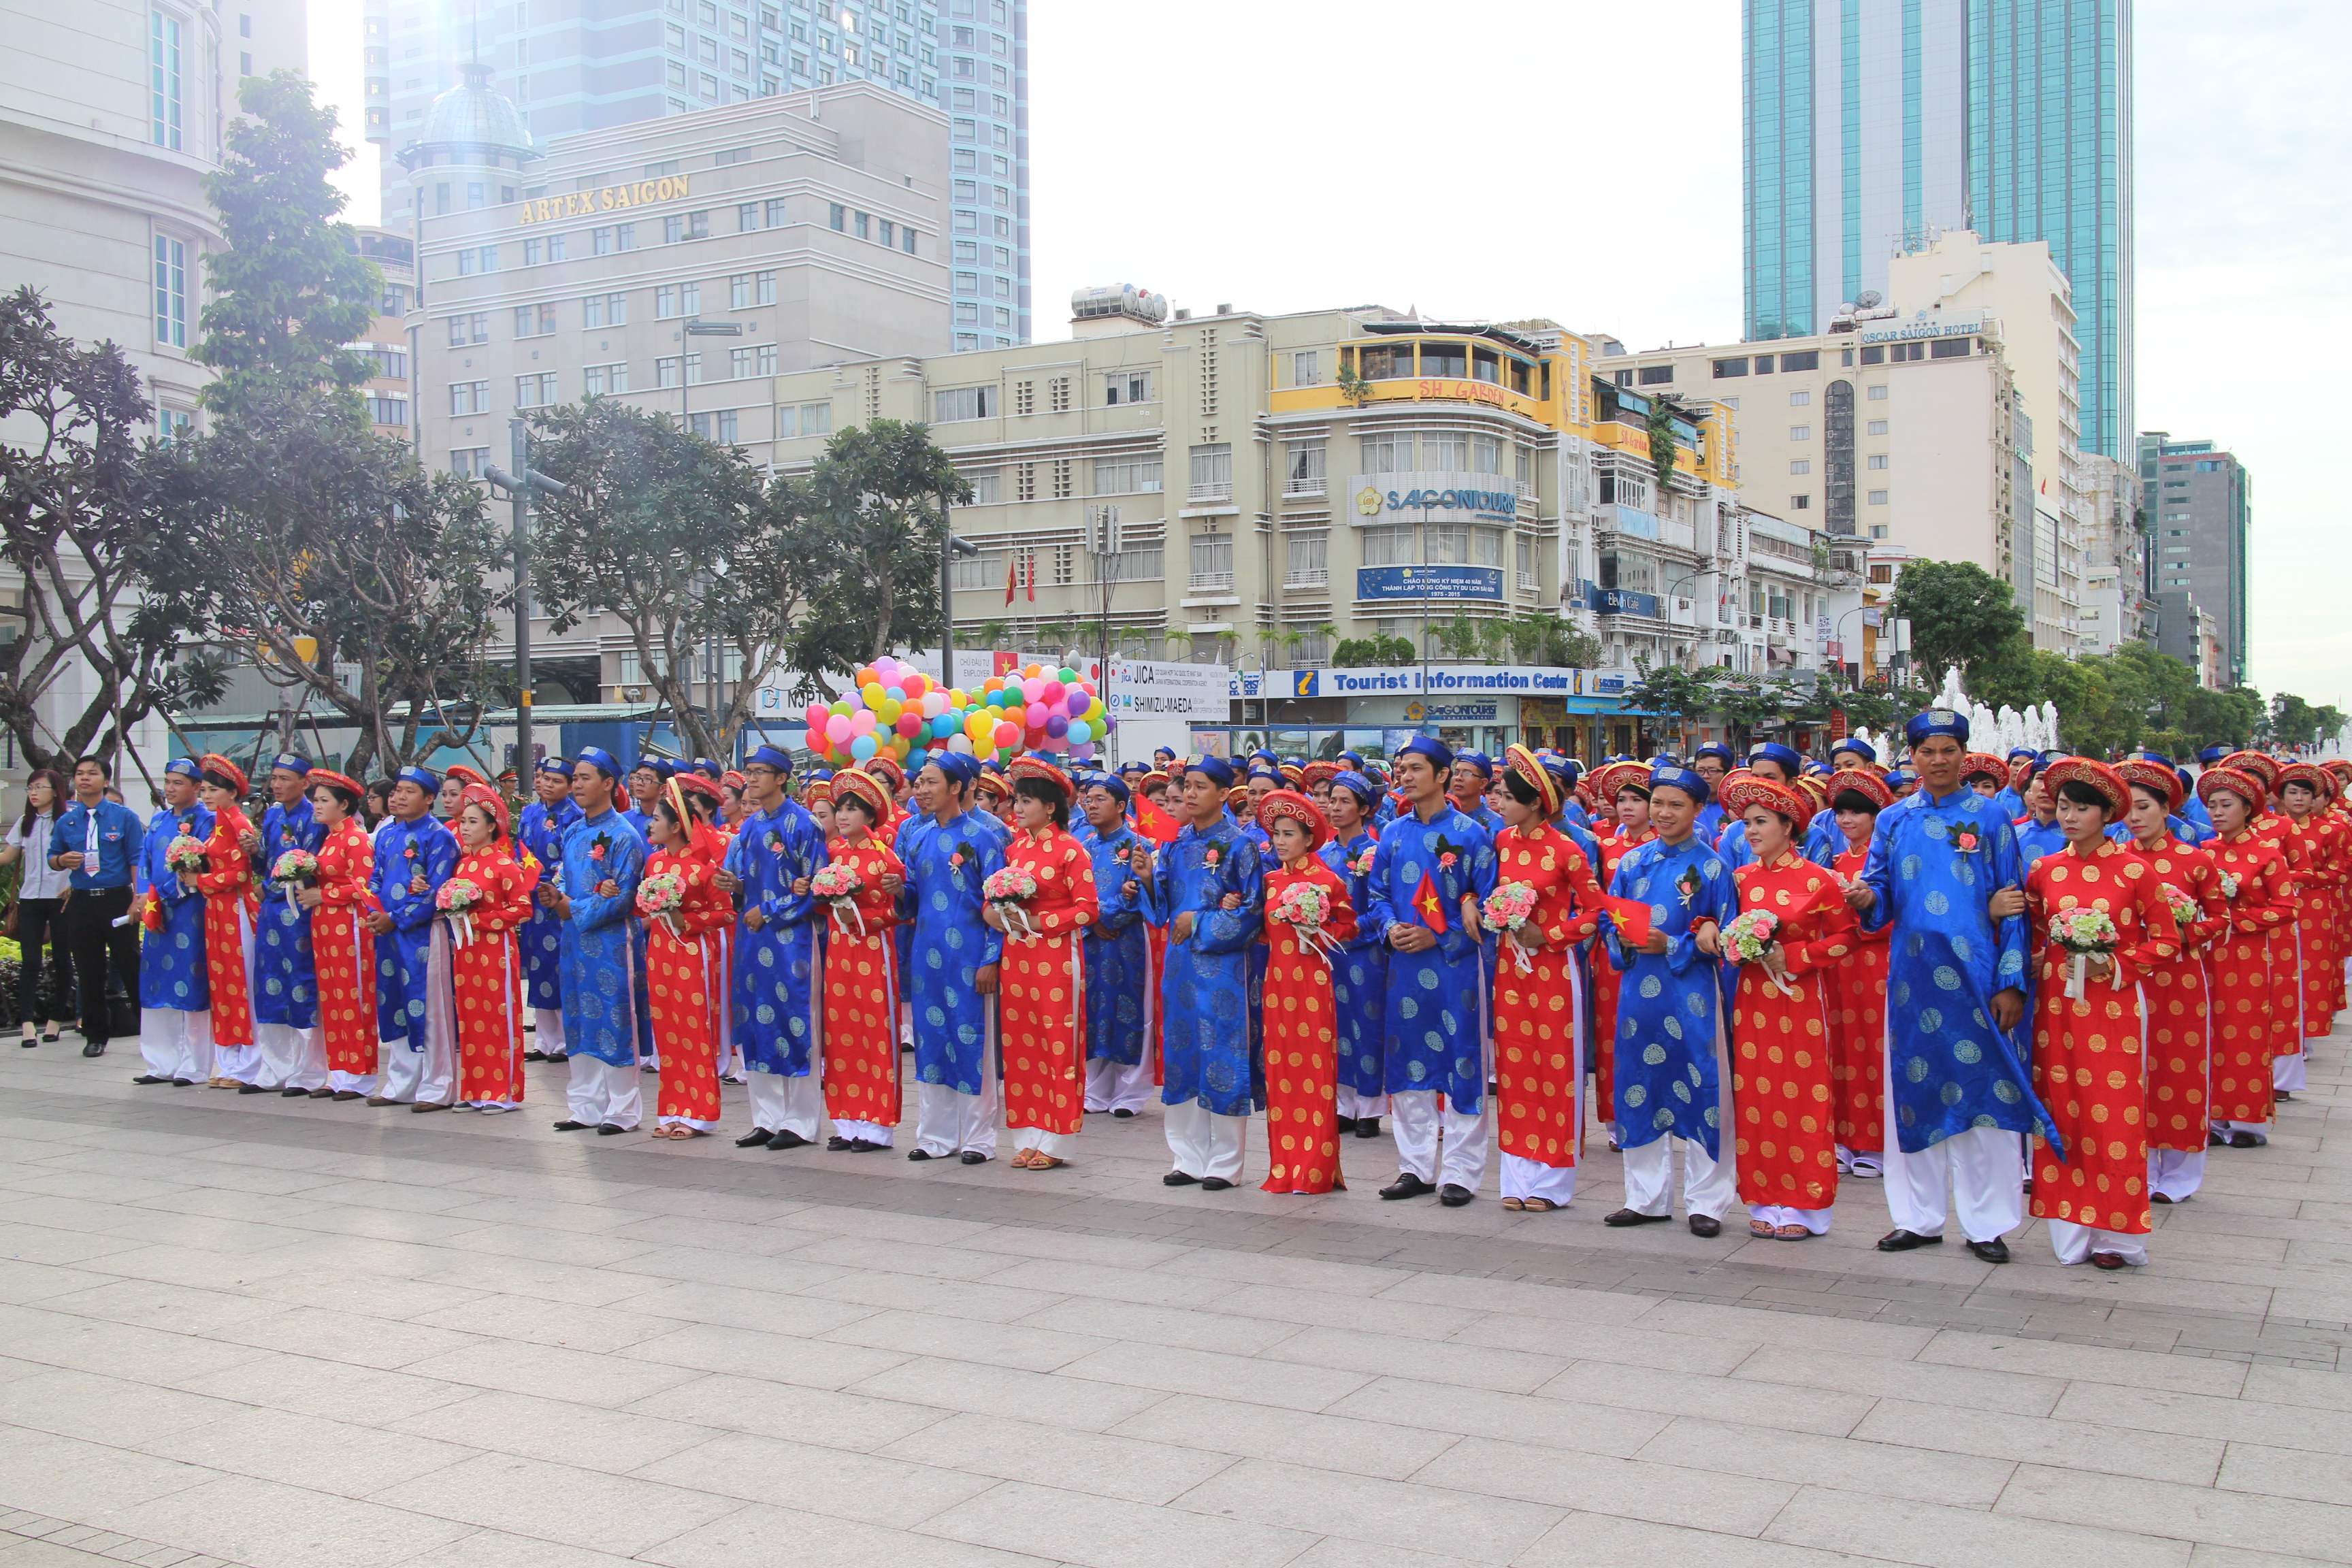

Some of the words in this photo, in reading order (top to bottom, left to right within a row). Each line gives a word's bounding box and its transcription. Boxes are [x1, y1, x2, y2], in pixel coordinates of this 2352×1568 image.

[519, 191, 595, 225] ARTEX
[601, 174, 689, 211] SAIGON
[1862, 331, 1897, 343] OSCAR
[1899, 326, 1941, 340] SAIGON
[1944, 323, 1982, 335] HOTEL
[1455, 382, 1505, 404] GARDEN
[1386, 489, 1516, 514] SAIGONTOURIST
[1627, 596, 1639, 610] Café
[960, 657, 971, 666] CHỦ
[1134, 665, 1155, 684] JICA
[1334, 672, 1407, 690] Tourist
[1415, 672, 1529, 689] Information
[1134, 696, 1192, 713] SHIMIZU-MAEDA
[1427, 705, 1497, 715] SAIGONTOURIST
